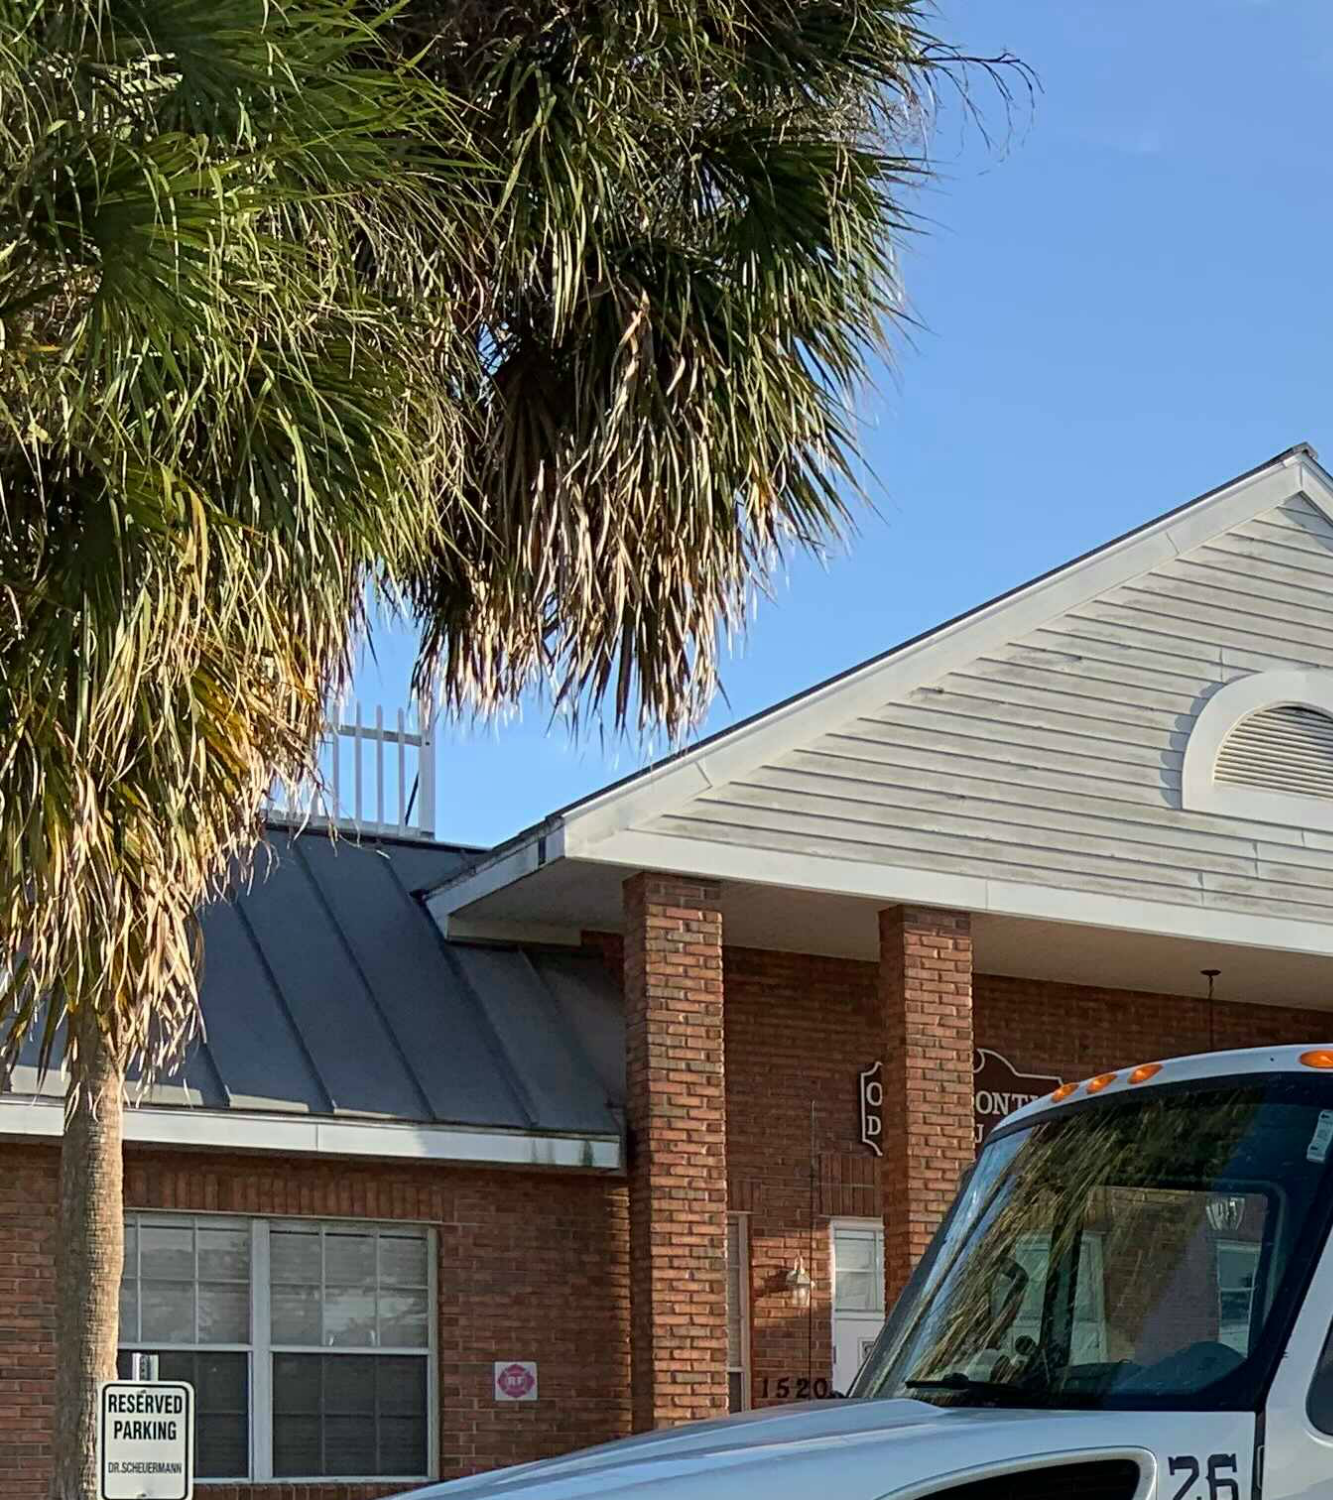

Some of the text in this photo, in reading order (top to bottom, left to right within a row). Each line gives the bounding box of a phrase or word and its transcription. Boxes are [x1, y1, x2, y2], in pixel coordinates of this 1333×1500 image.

[761, 1377, 829, 1399] 1520
[108, 1394, 183, 1414] RESERVED
[113, 1421, 177, 1440] PARKING
